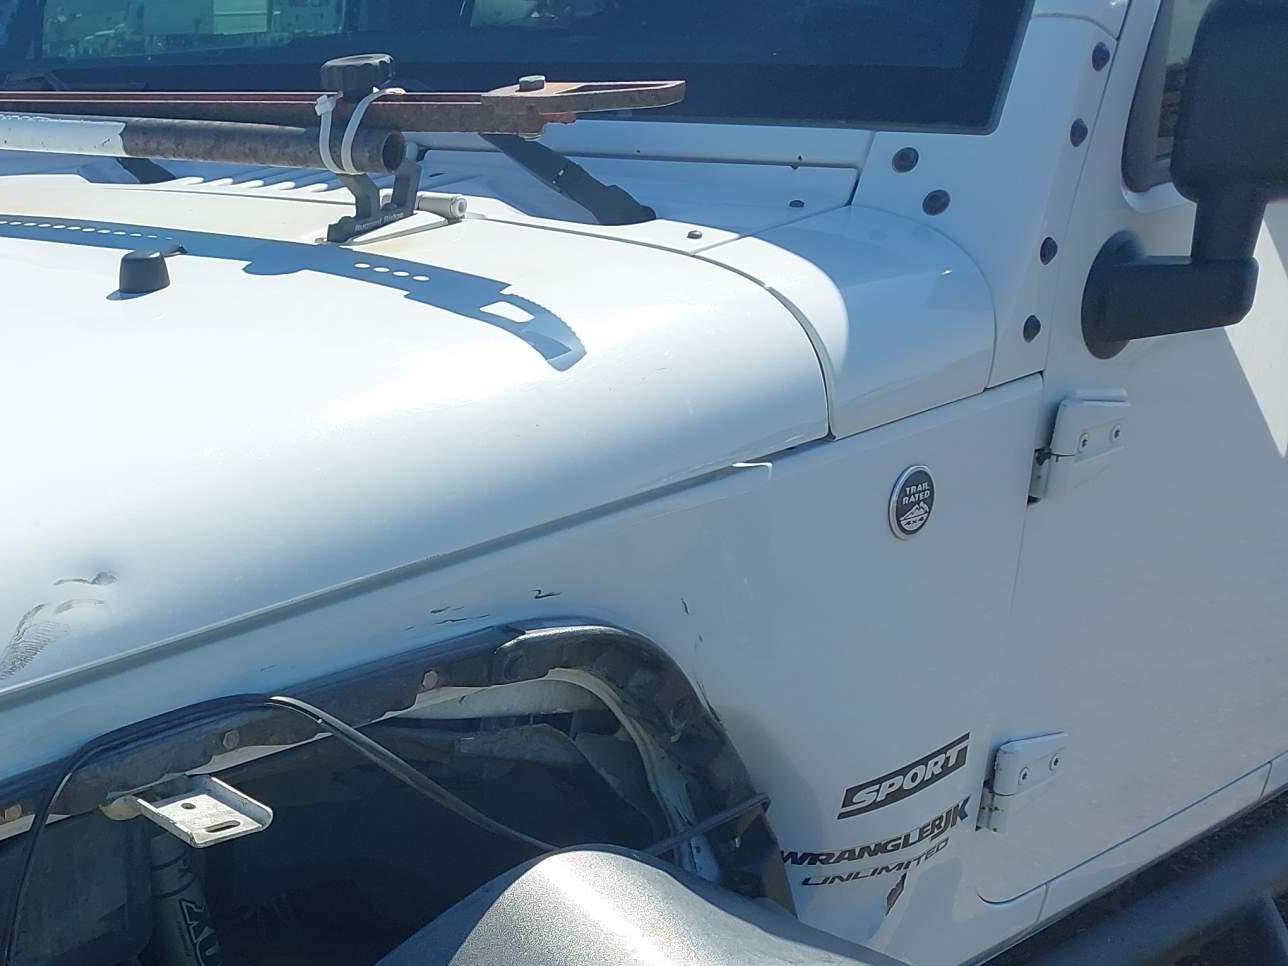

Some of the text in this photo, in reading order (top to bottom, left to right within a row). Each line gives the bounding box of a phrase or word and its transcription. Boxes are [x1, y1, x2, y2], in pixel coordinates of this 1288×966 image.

[902, 490, 931, 505] RATED
[905, 482, 930, 495] TRAIL
[852, 747, 963, 808] SPORT
[801, 837, 950, 886] UNLIMITED
